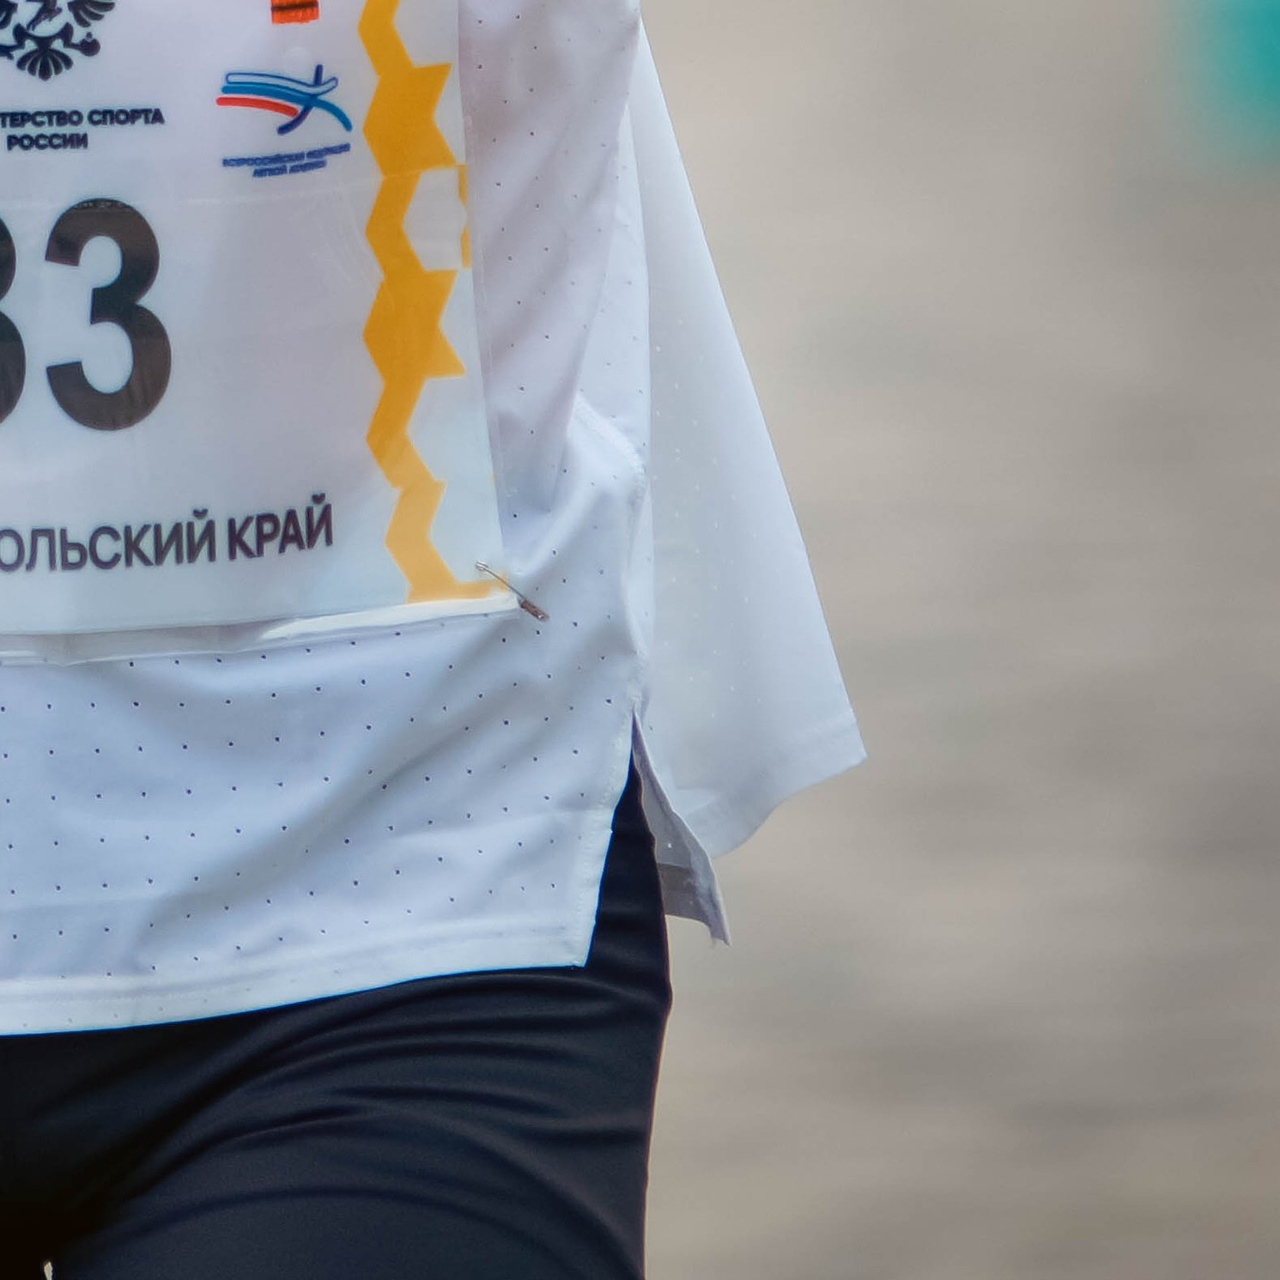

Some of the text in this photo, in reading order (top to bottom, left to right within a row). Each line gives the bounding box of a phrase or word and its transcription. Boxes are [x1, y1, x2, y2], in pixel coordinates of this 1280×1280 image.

[87, 108, 166, 126] СПОРТА
[6, 132, 89, 151] РОССИИ
[227, 492, 334, 561] КРАЙ
